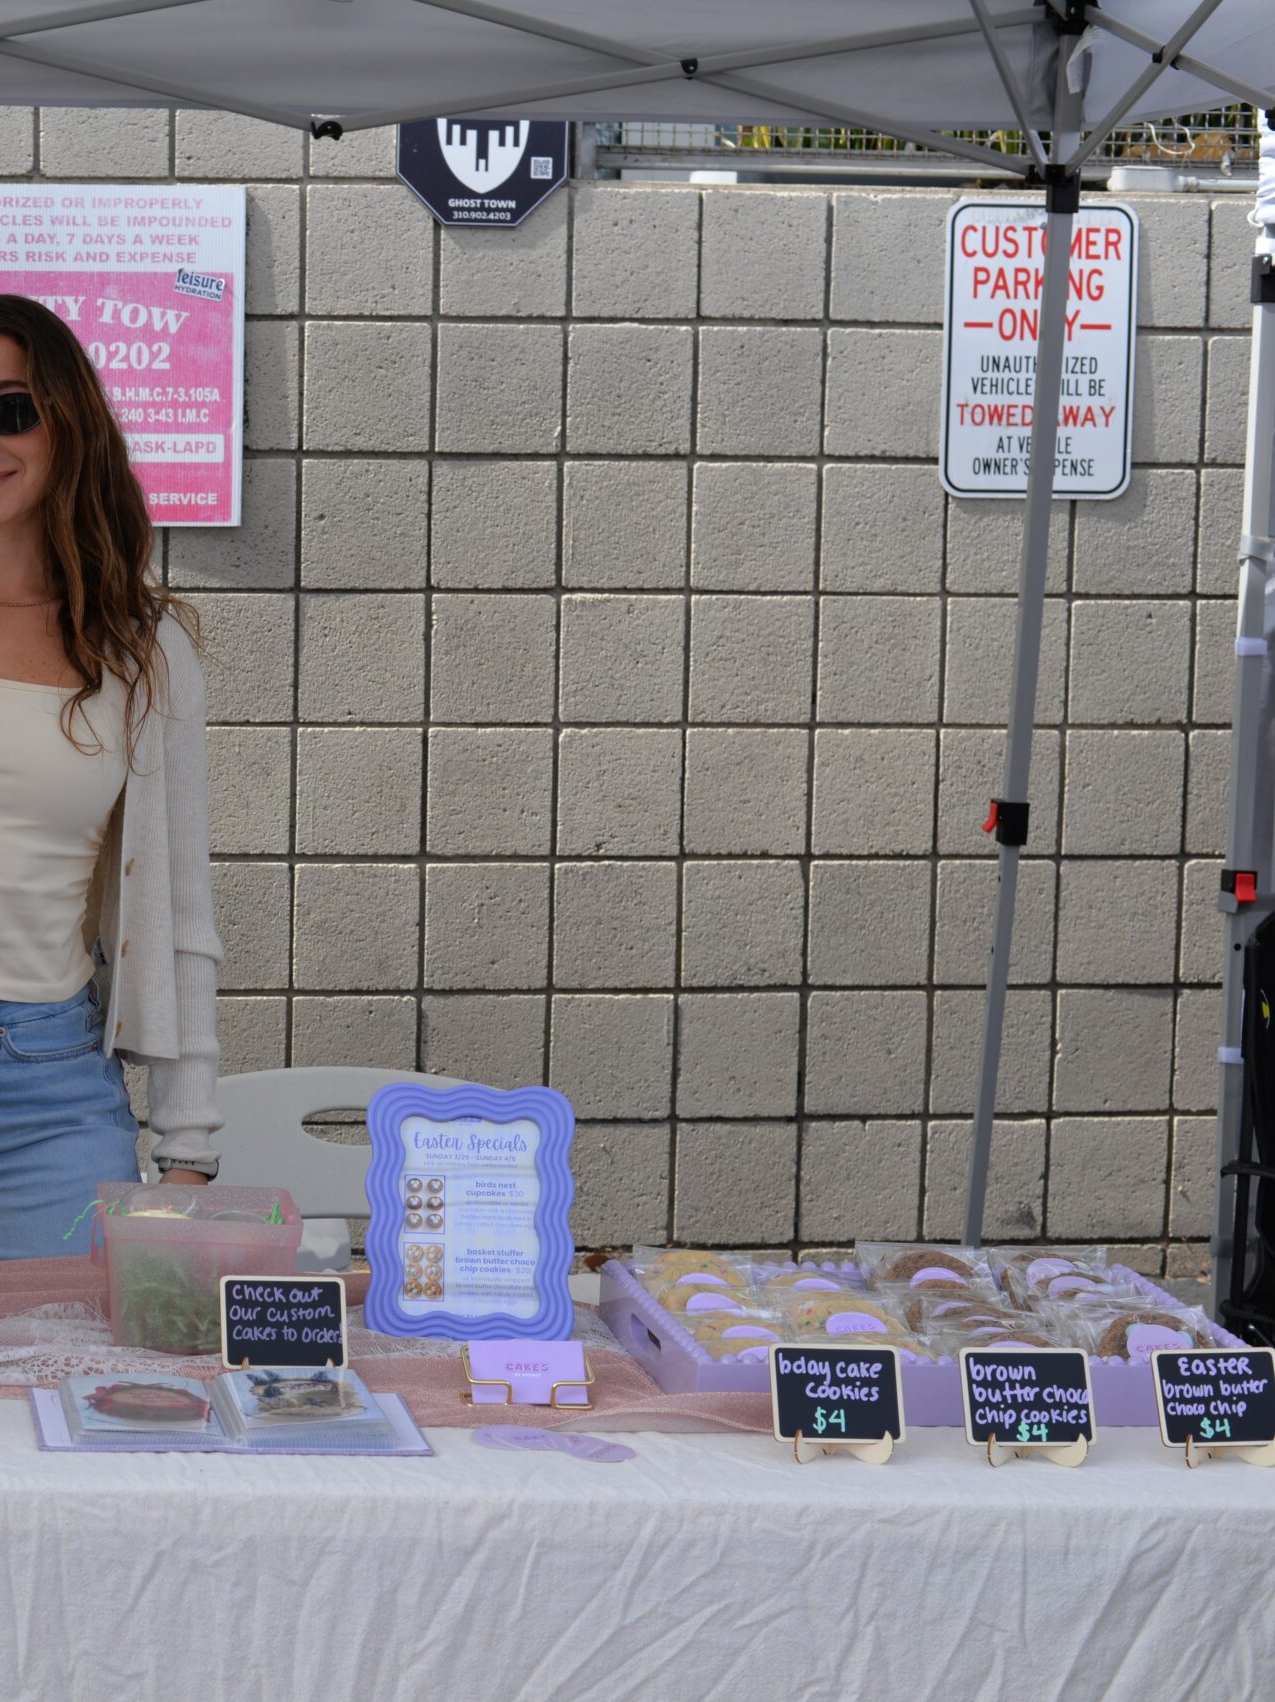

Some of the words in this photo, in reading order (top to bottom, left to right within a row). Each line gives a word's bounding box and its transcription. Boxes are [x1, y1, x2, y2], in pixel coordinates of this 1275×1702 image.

[61, 197, 86, 209] OR
[92, 197, 204, 210] IMPROPERLY
[448, 198, 482, 209] GHOST
[484, 199, 516, 209] TOWN
[50, 215, 92, 228] WILL
[98, 215, 120, 228] BE
[127, 216, 233, 229] IMPOUNDED
[6, 233, 18, 245] A
[66, 233, 76, 245] 7
[82, 233, 126, 246] DAYS
[132, 234, 145, 246] A
[150, 234, 200, 247] WEEK
[25, 251, 67, 264] RISK
[72, 251, 110, 264] AND
[116, 252, 197, 265] EXPENSE
[176, 268, 224, 292] leisure
[973, 266, 1105, 302] PARKNG
[175, 284, 222, 300] HYDRATION
[96, 298, 191, 335] TOW
[998, 308, 1081, 342] ONY
[971, 377, 1037, 396] VEHICLE
[1088, 379, 1107, 397] BE
[956, 403, 1035, 427] TOWED
[1056, 404, 1116, 429] WAY
[996, 435, 1014, 454] AT
[148, 492, 218, 505] SERVICE
[414, 1131, 463, 1151] Easter
[467, 1133, 528, 1154] Specials
[466, 1189, 506, 1198] cupcakes
[509, 1190, 524, 1198] $30
[475, 1180, 497, 1189] birds
[498, 1182, 517, 1190] nest
[455, 1256, 482, 1264] brown
[467, 1248, 496, 1257] basket
[497, 1249, 525, 1257] stuffer
[459, 1264, 478, 1274] chip
[479, 1265, 512, 1274] cookies
[289, 1286, 324, 1303] out
[281, 1324, 298, 1342] to
[1136, 1343, 1181, 1353] CAKES
[506, 1363, 549, 1372] CAKES
[778, 1352, 832, 1386] bday
[969, 1356, 1037, 1382] brown
[972, 1382, 1040, 1404] butter
[1162, 1378, 1214, 1399] brown
[1219, 1378, 1269, 1396] butter
[812, 1406, 846, 1434] $4
[975, 1404, 1017, 1430] chip
[1020, 1405, 1088, 1425] cookies
[1016, 1419, 1049, 1442] $4
[1199, 1417, 1232, 1439] $4
